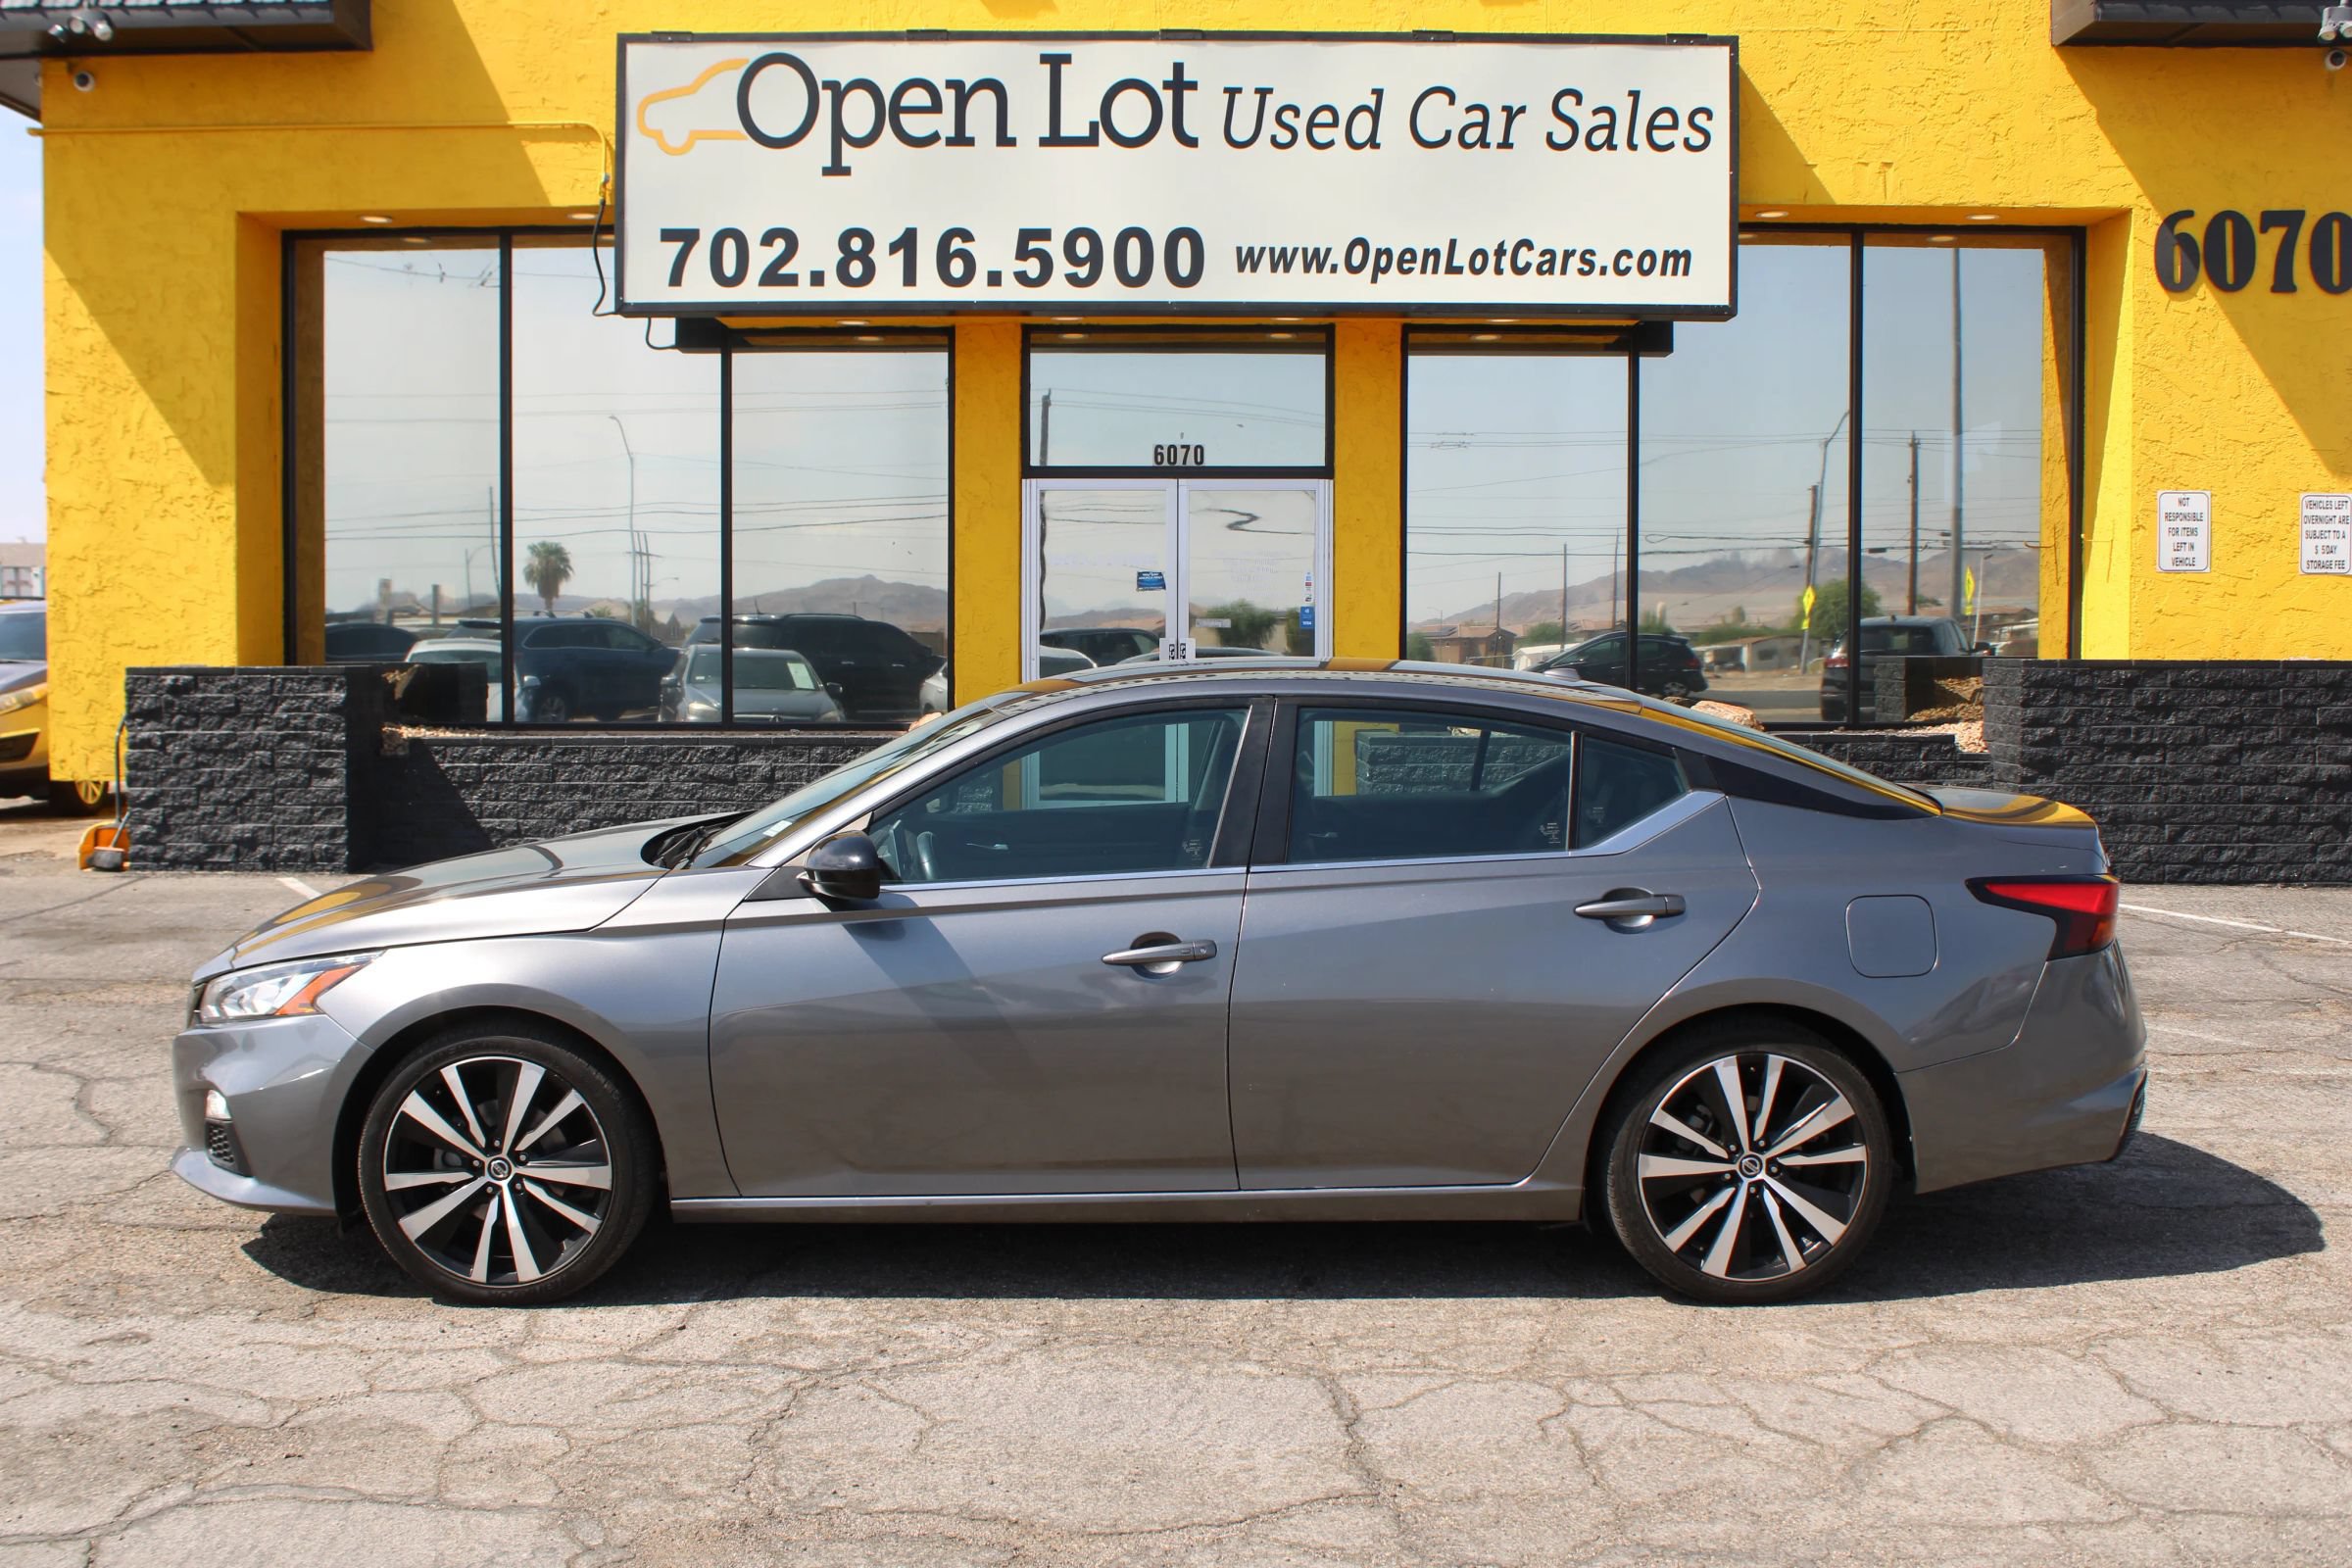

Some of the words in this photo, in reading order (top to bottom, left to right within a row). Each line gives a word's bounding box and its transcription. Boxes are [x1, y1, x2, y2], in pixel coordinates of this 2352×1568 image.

[736, 52, 1017, 176] Open
[1039, 53, 1199, 148] Lot
[1223, 87, 1384, 150] Used
[1408, 85, 1527, 150] Car
[1545, 88, 1714, 153] Sales
[660, 226, 1205, 288] 702.816.5900
[2154, 209, 2352, 295] 6070
[1236, 237, 1692, 284] www.OpenLotCars.com
[1153, 444, 1205, 466] 6070
[2178, 497, 2190, 507] NOT
[2305, 500, 2333, 510] VEHICLES
[2334, 500, 2348, 510] LEFT
[2164, 512, 2204, 522] RESPONSIBLE
[2304, 514, 2336, 524] OVERNIGHT
[2338, 514, 2349, 524] ARE
[2168, 527, 2180, 537] FOR
[2180, 527, 2198, 537] ITEMS
[2305, 529, 2331, 539] SUBJECT
[2332, 530, 2340, 539] TO
[2341, 530, 2346, 539] A
[2173, 542, 2187, 552] LEFT
[2188, 542, 2194, 552] IN
[2172, 557, 2196, 566] VEHICLE
[2306, 560, 2332, 569] STORAGE
[2334, 560, 2345, 569] FEE
